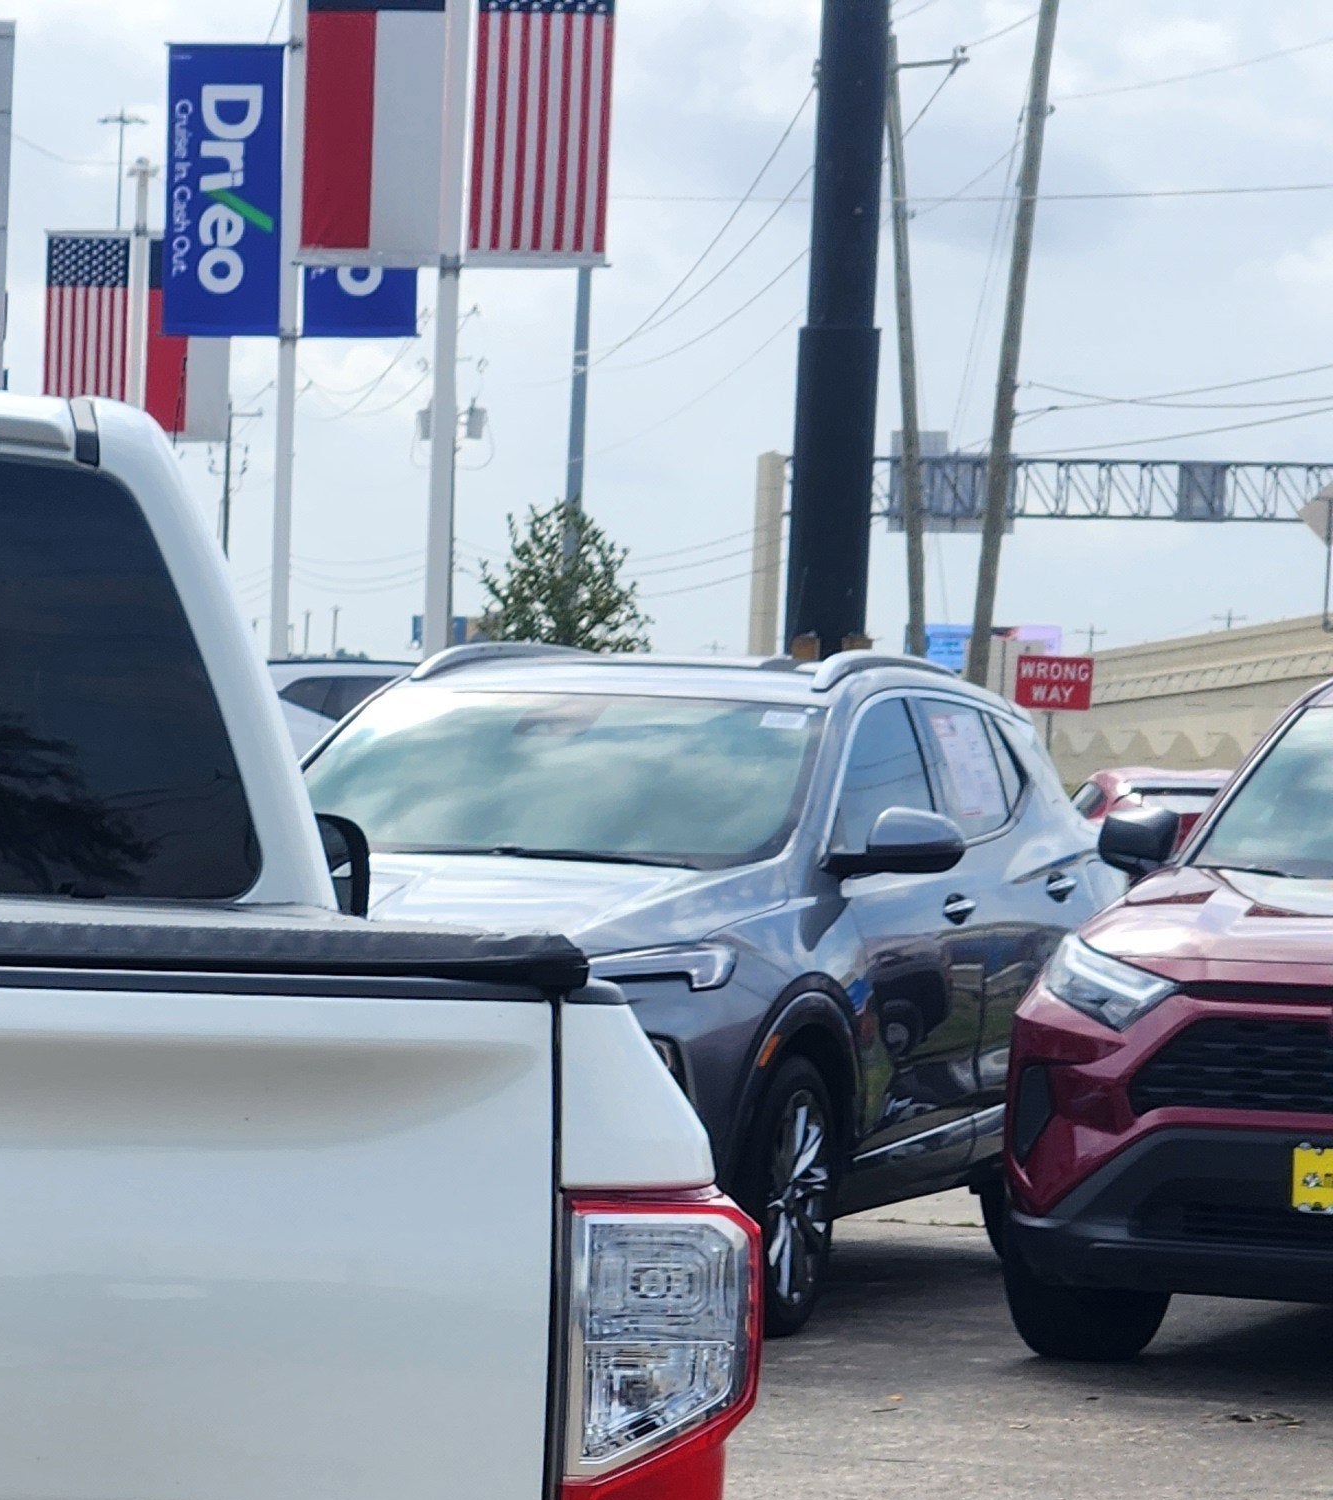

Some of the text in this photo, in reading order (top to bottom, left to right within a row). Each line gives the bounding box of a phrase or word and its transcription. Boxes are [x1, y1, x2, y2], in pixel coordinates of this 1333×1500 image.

[174, 99, 193, 159] Cruise
[173, 185, 191, 232] Cash
[1020, 661, 1091, 682] WRONG
[1032, 684, 1074, 702] WAY
